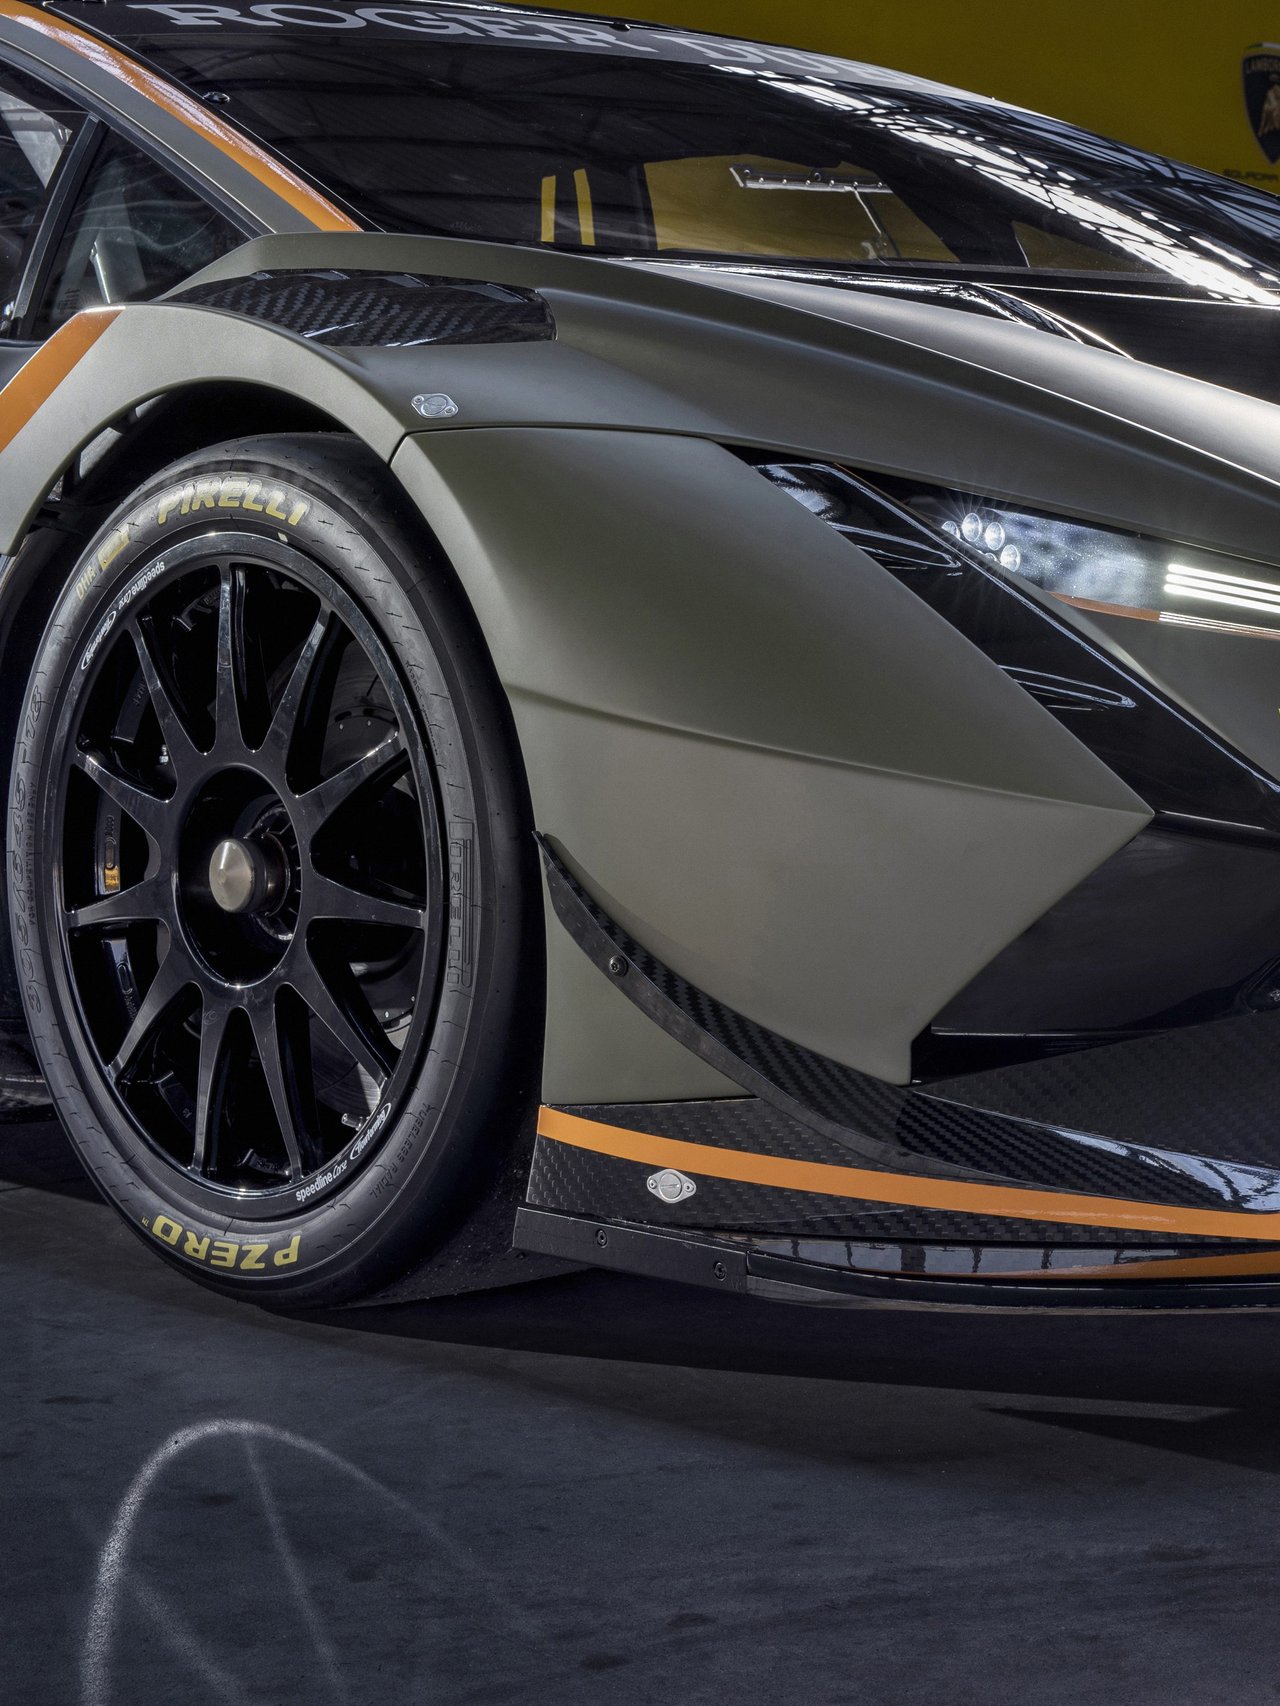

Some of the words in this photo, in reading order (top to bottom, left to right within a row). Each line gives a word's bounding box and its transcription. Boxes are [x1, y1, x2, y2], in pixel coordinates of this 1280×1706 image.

[128, 3, 658, 53] ROGER
[157, 476, 309, 527] PIRELLI
[447, 822, 475, 988] PIRELLI
[398, 1103, 432, 1163] TUBELESS
[296, 1172, 333, 1201] speedline
[369, 1163, 399, 1199] RADIAL
